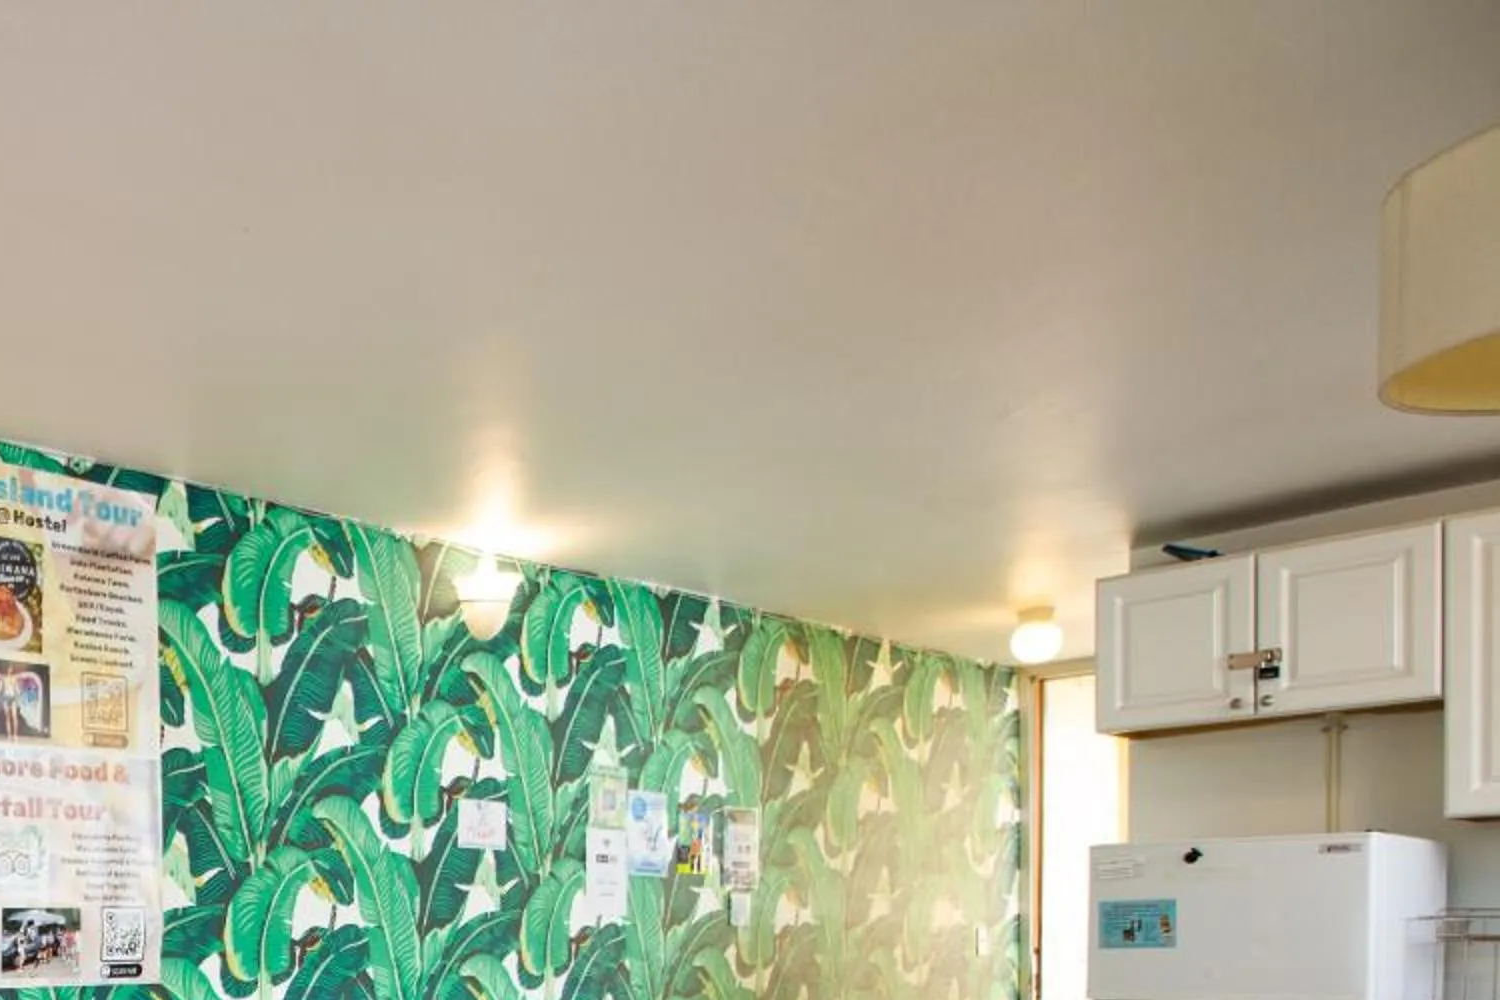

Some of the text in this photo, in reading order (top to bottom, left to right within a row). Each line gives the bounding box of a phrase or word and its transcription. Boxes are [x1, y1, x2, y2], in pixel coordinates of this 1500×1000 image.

[77, 489, 143, 528] Tour
[13, 509, 67, 536] Hostel
[49, 757, 107, 783] Food
[113, 762, 131, 785] &
[46, 797, 107, 821] Tour
